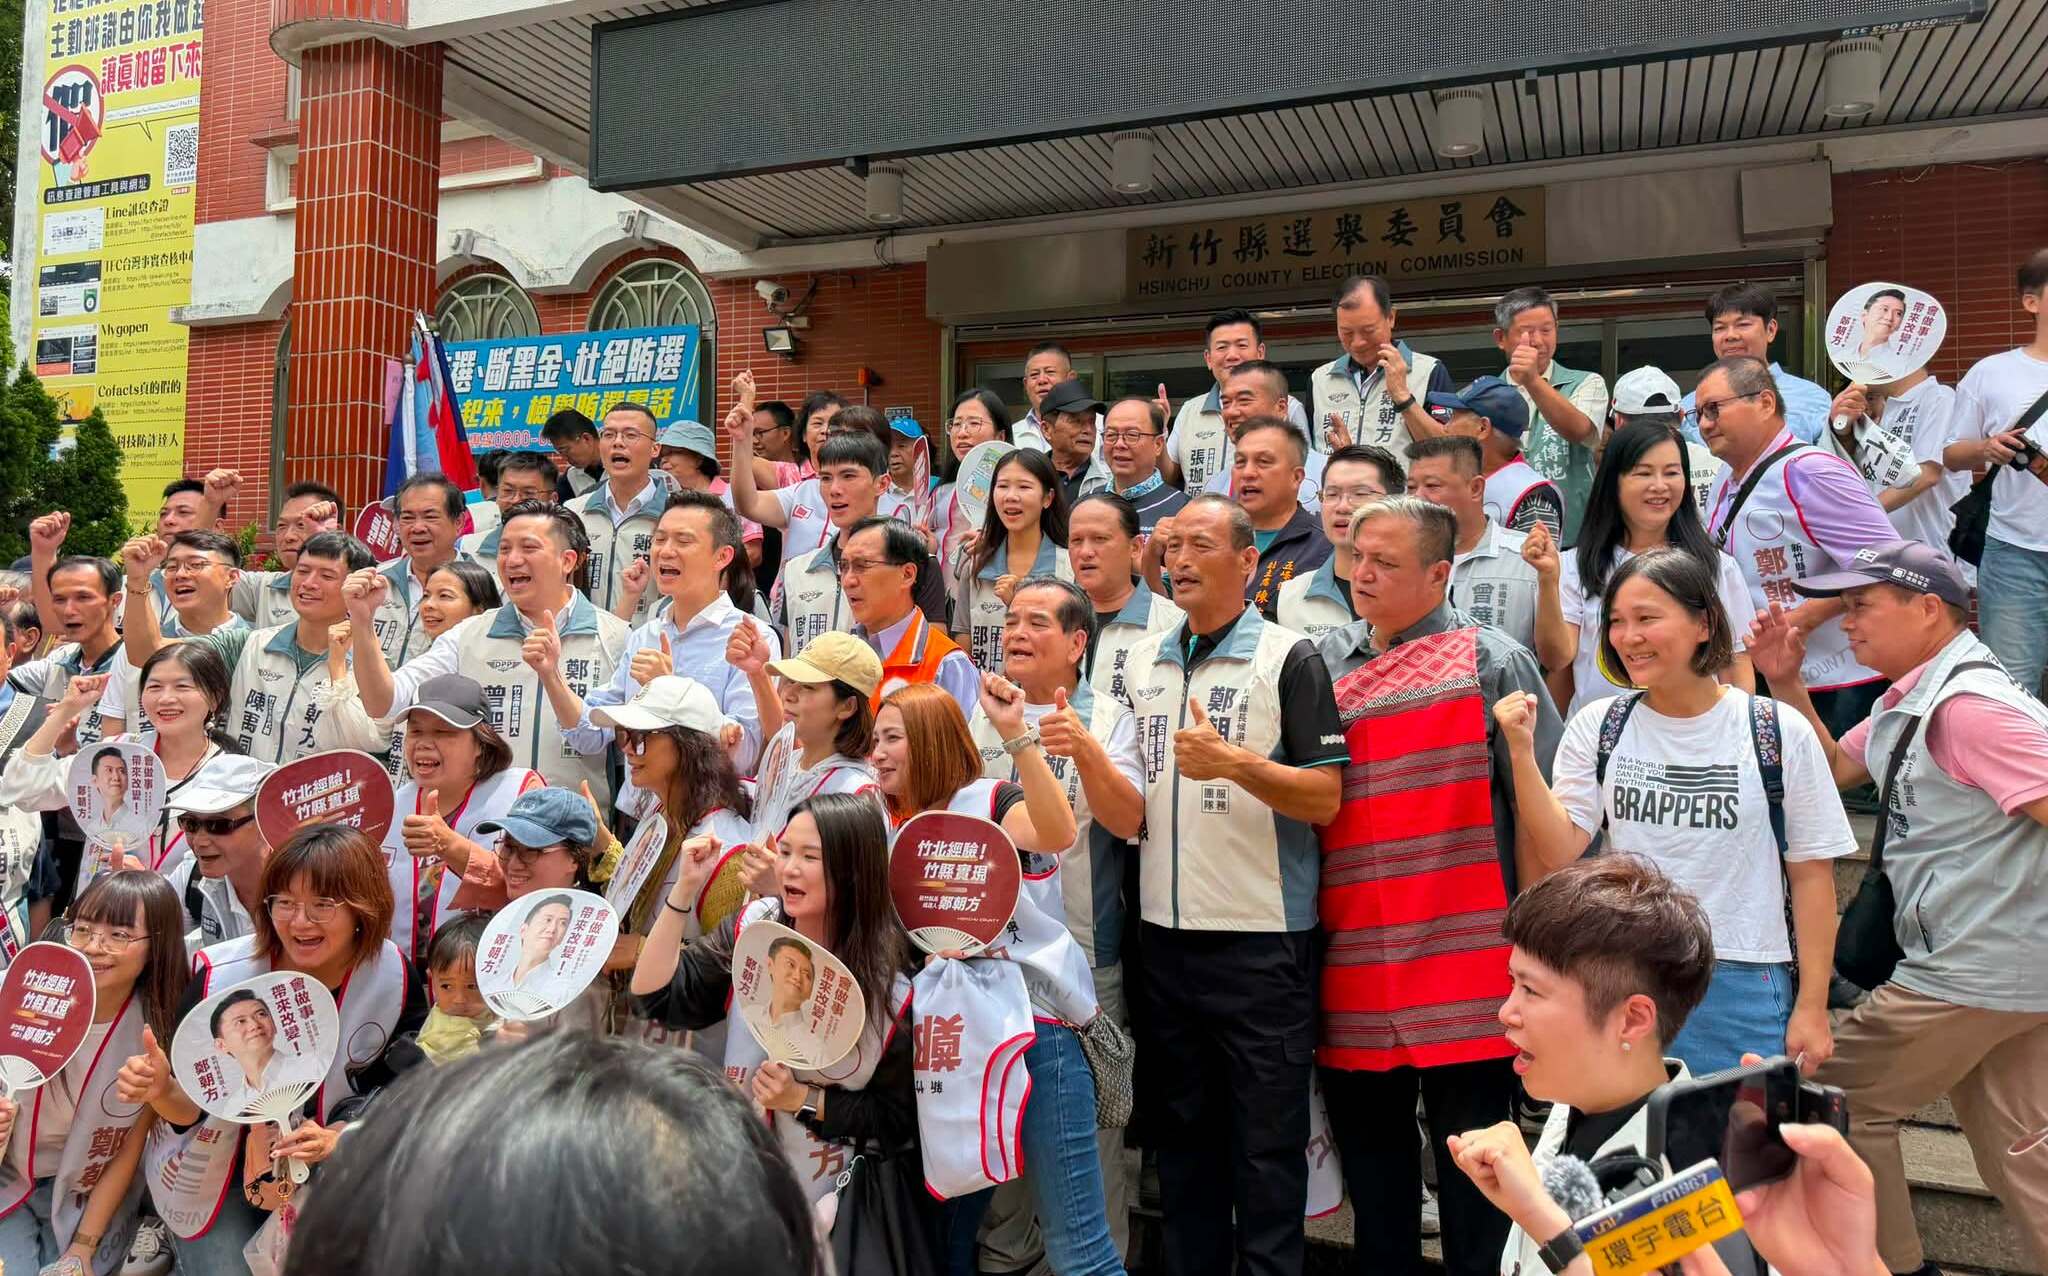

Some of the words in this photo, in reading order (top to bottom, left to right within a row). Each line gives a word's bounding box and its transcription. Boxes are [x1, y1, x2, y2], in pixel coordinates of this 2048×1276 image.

[1141, 196, 1528, 269] 新竹縣選舉委員會
[1137, 276, 1210, 297] HSINCHU
[1222, 269, 1293, 289] COUNTY
[1302, 260, 1389, 281] ELECTION
[1400, 247, 1524, 273] COMMISSION
[1616, 763, 1645, 773] WHERE
[1648, 769, 1664, 777] YOU
[1635, 759, 1664, 770] WORLD
[1613, 785, 1739, 830] BRAPPERS
[938, 895, 982, 912] 鄭朝方
[1602, 1197, 1727, 1268] 環宇電台
